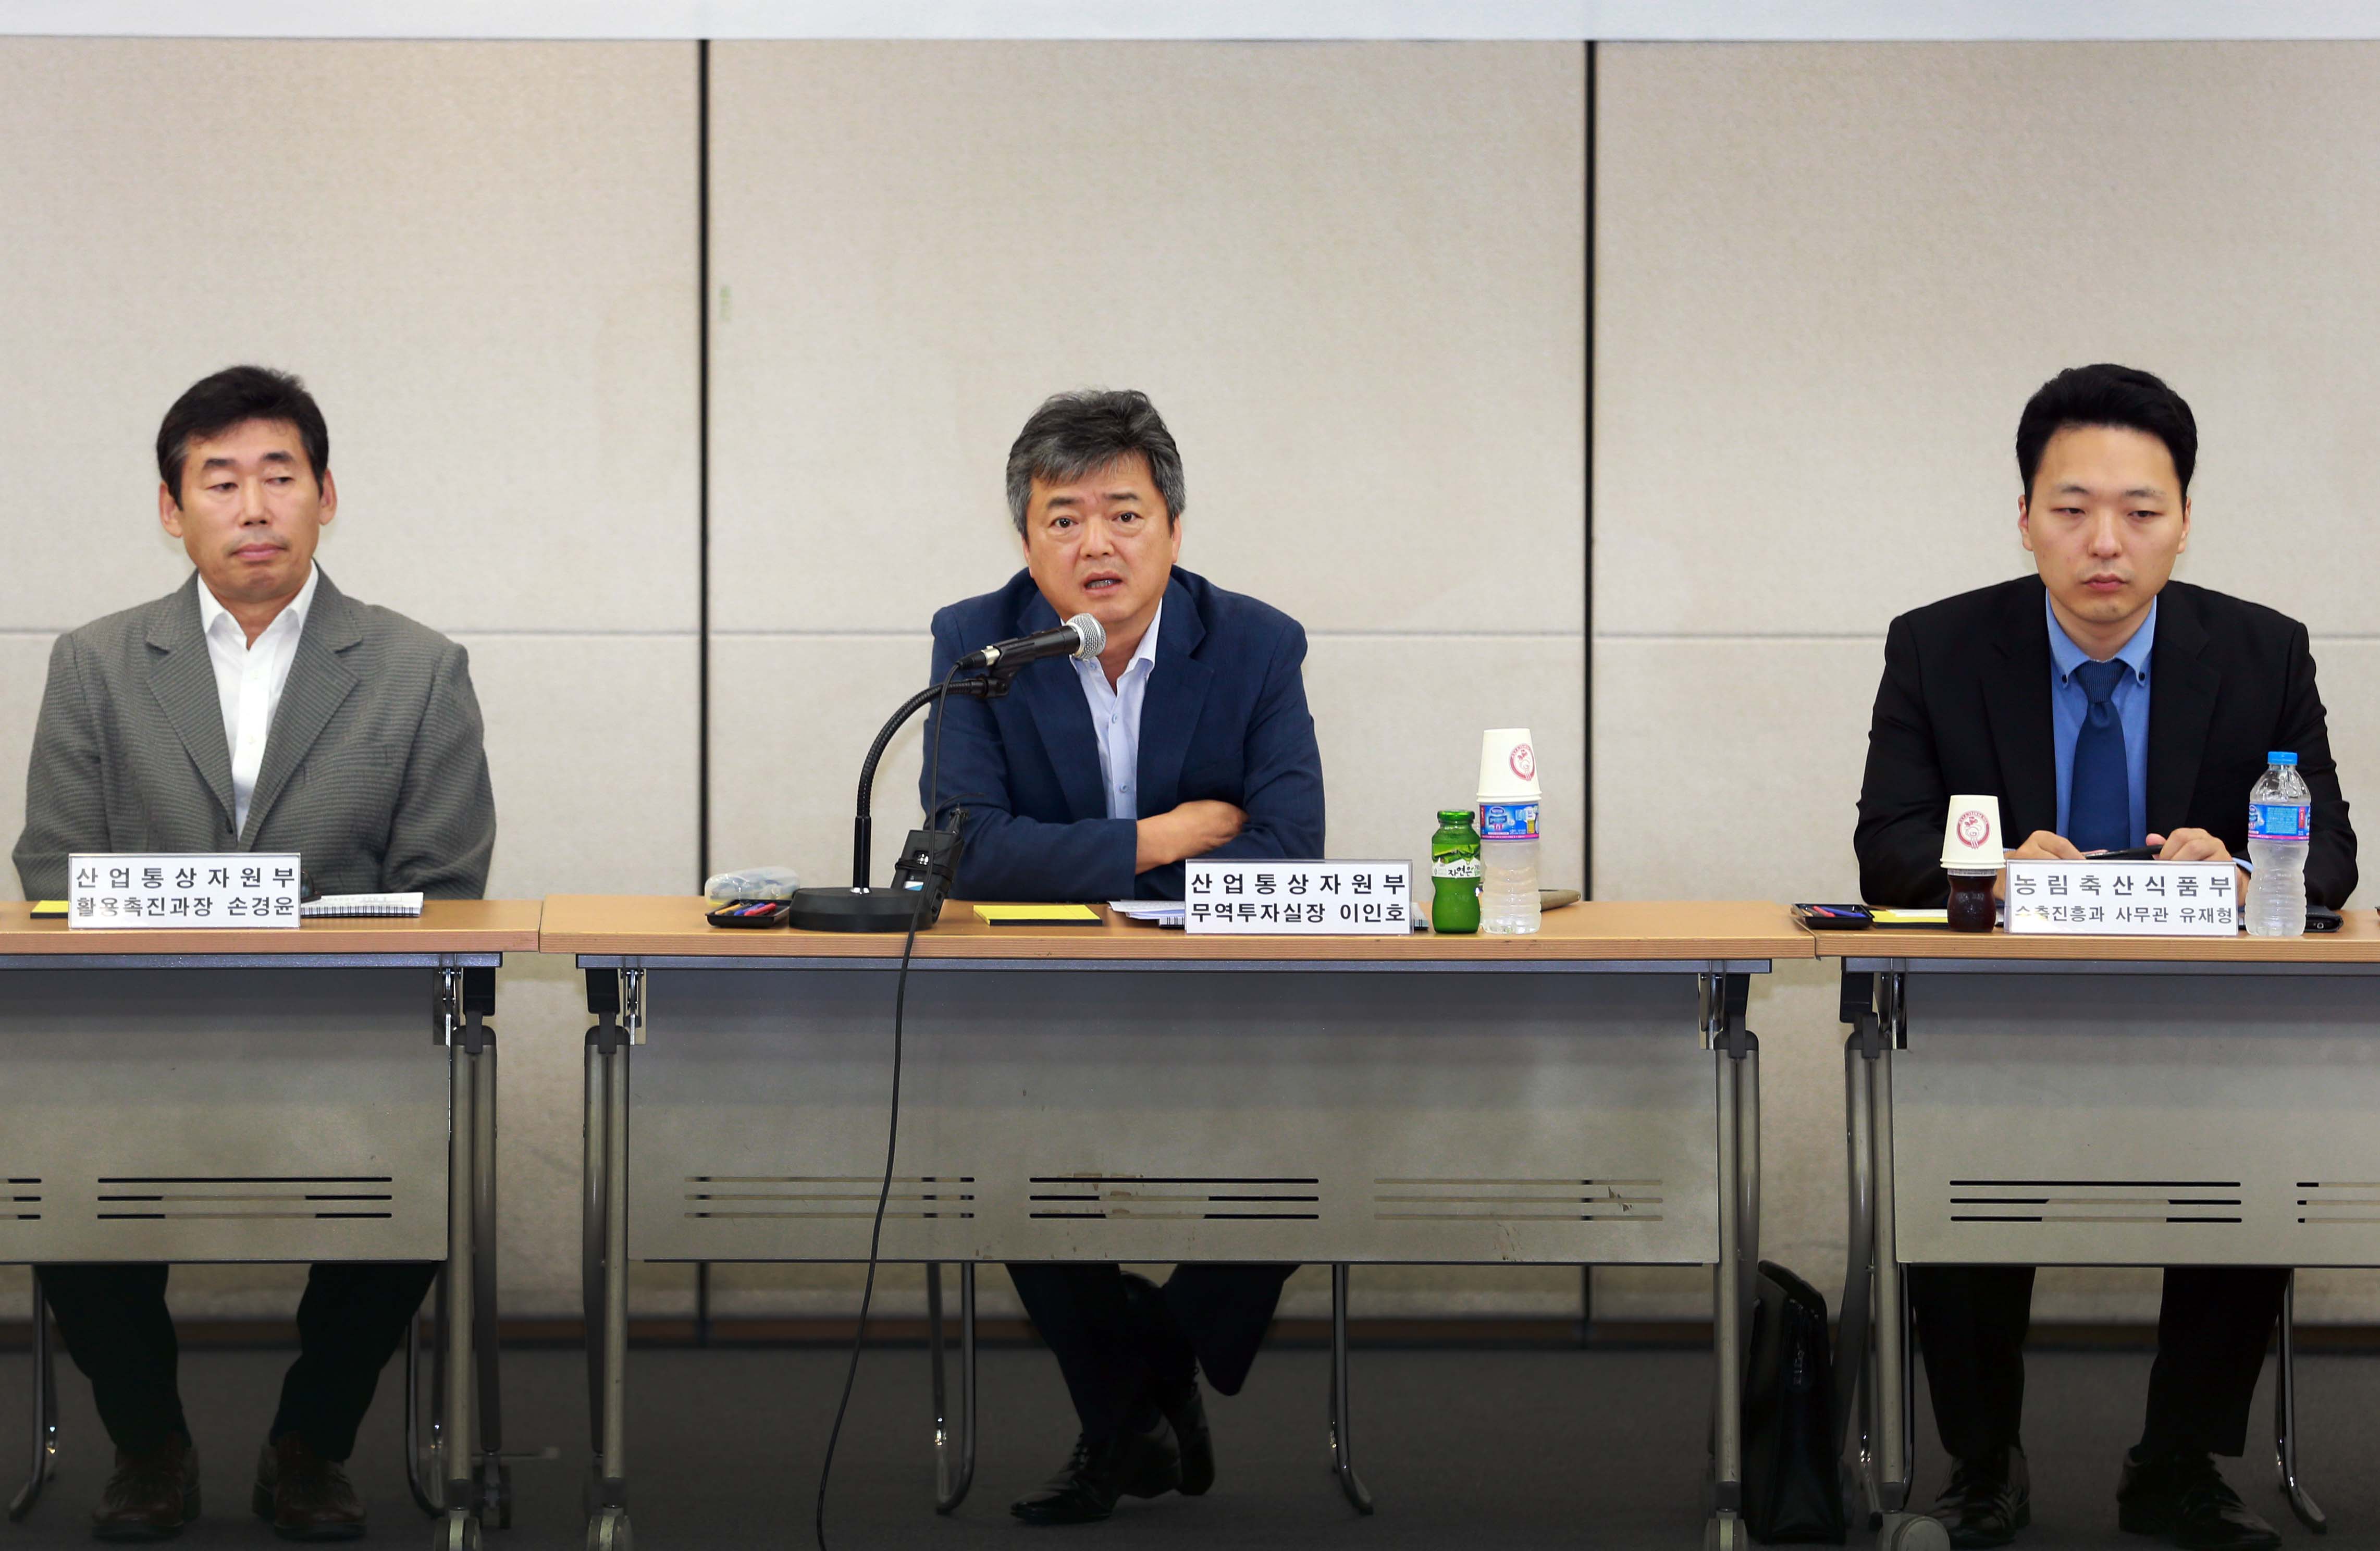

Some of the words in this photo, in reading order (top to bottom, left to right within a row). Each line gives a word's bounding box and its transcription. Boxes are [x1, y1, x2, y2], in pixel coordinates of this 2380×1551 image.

[77, 867, 295, 889] 산업통상자원부
[1448, 865, 1472, 877] 자연은
[1191, 873, 1405, 895] 산업통상자원부
[2014, 874, 2231, 897] 농림축산식품부
[77, 896, 213, 917] 활용촉진과장
[227, 896, 294, 917] 손경윤
[1191, 903, 1326, 924] 무역투자실장
[1340, 903, 1405, 924] 이인호
[2115, 906, 2169, 923] 사무관
[2179, 907, 2232, 925] 유재형
